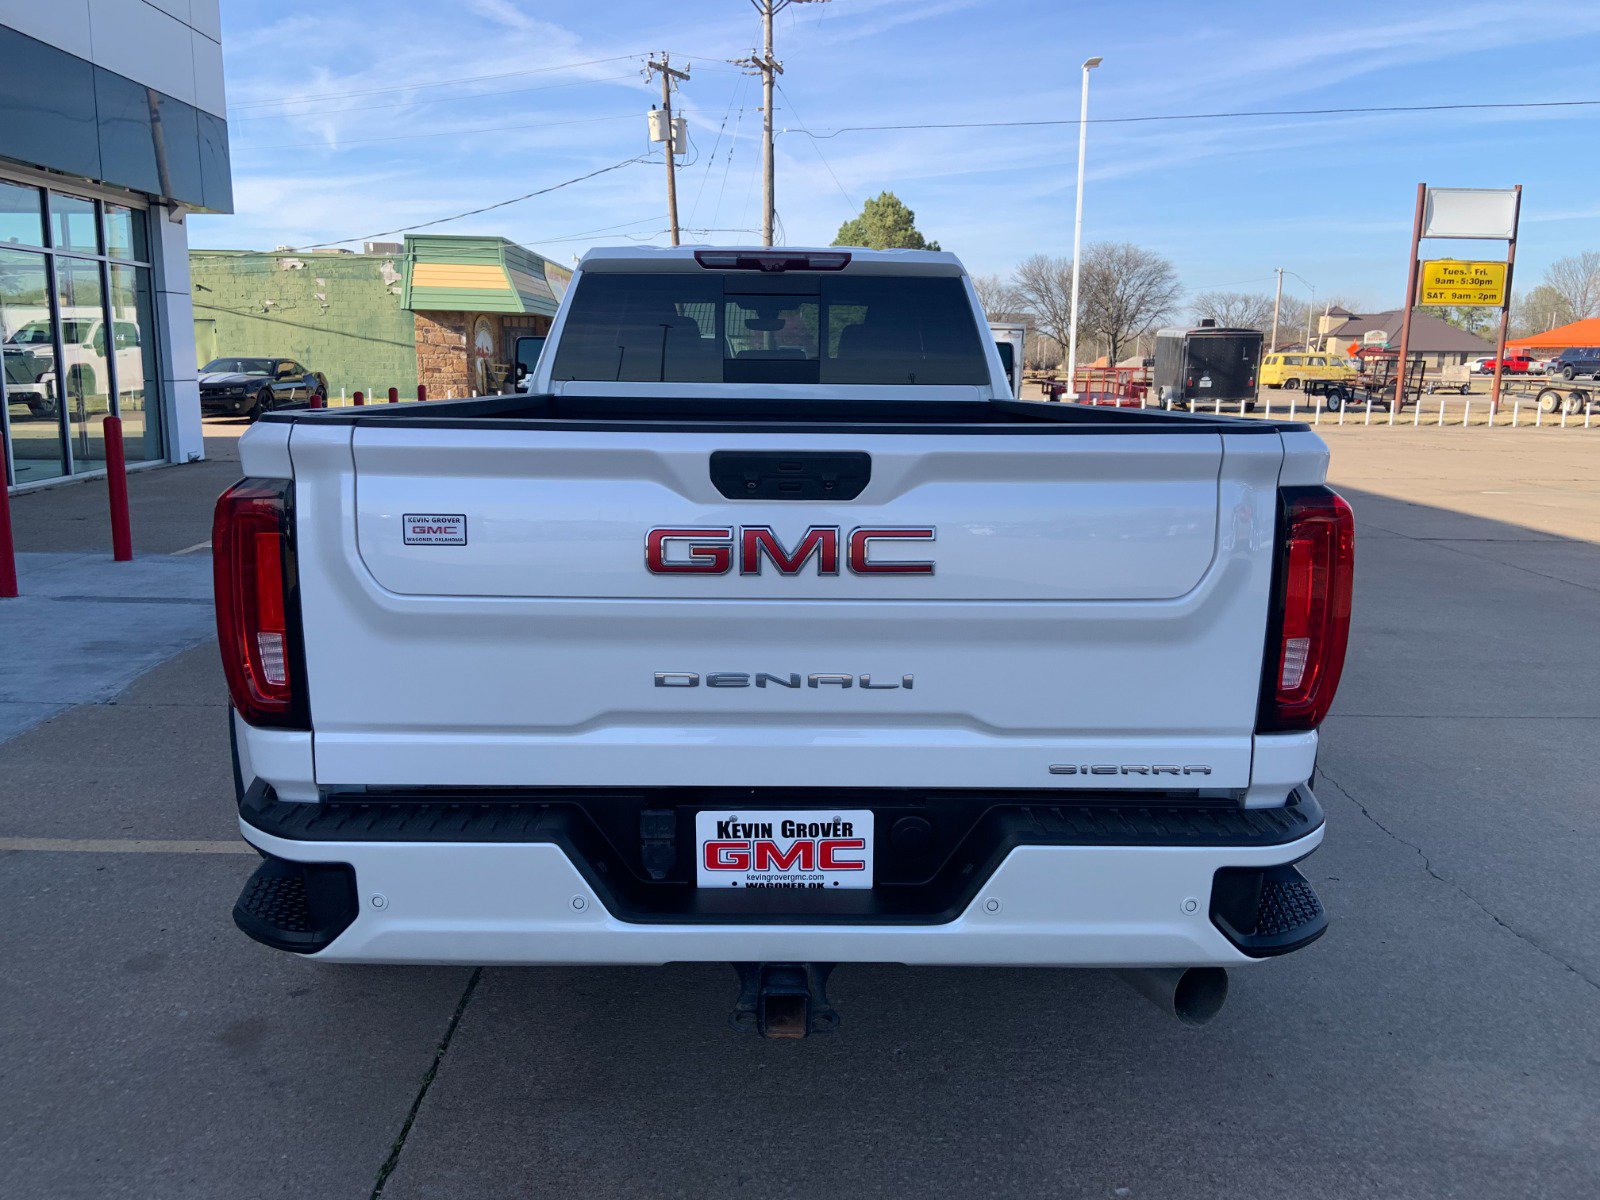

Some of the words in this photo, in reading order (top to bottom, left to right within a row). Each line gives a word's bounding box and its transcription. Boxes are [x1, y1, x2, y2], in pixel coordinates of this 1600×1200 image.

[1461, 278, 1493, 286] 5:30pm
[412, 526, 457, 534] GMC
[644, 525, 936, 576] GMC
[654, 672, 914, 689] DENALI
[1049, 764, 1212, 775] SIERRA
[703, 838, 866, 872] GMC
[746, 873, 825, 882] kevingrovergmc.com
